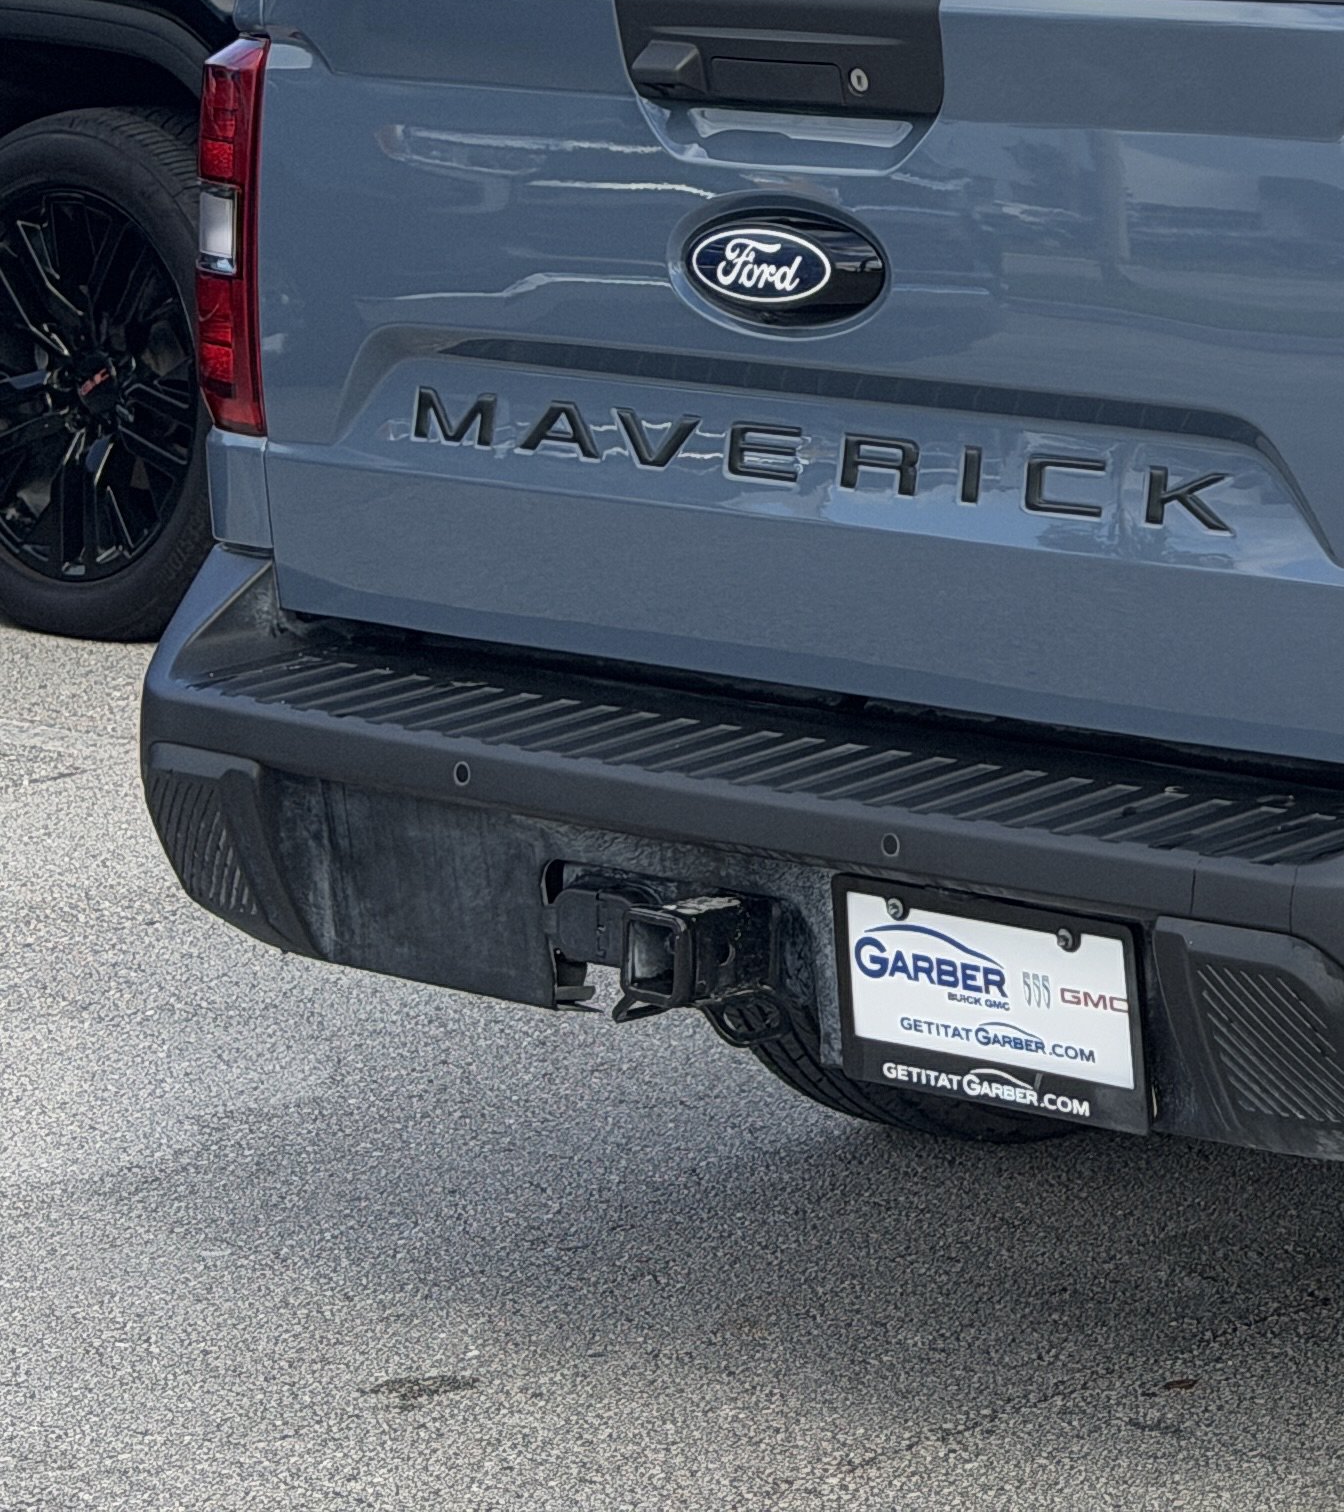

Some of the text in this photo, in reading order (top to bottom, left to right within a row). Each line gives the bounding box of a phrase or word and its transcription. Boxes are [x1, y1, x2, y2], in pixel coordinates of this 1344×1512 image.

[716, 237, 803, 292] Ford
[412, 384, 1237, 536] MAVERICK
[854, 935, 1009, 999] GARBER
[947, 991, 1011, 1012] BUICK GMC
[1060, 987, 1129, 1014] GMC
[899, 1016, 1096, 1065] GETITATGARBER.COM
[882, 1061, 1091, 1118] GETITATGARBER.COM
